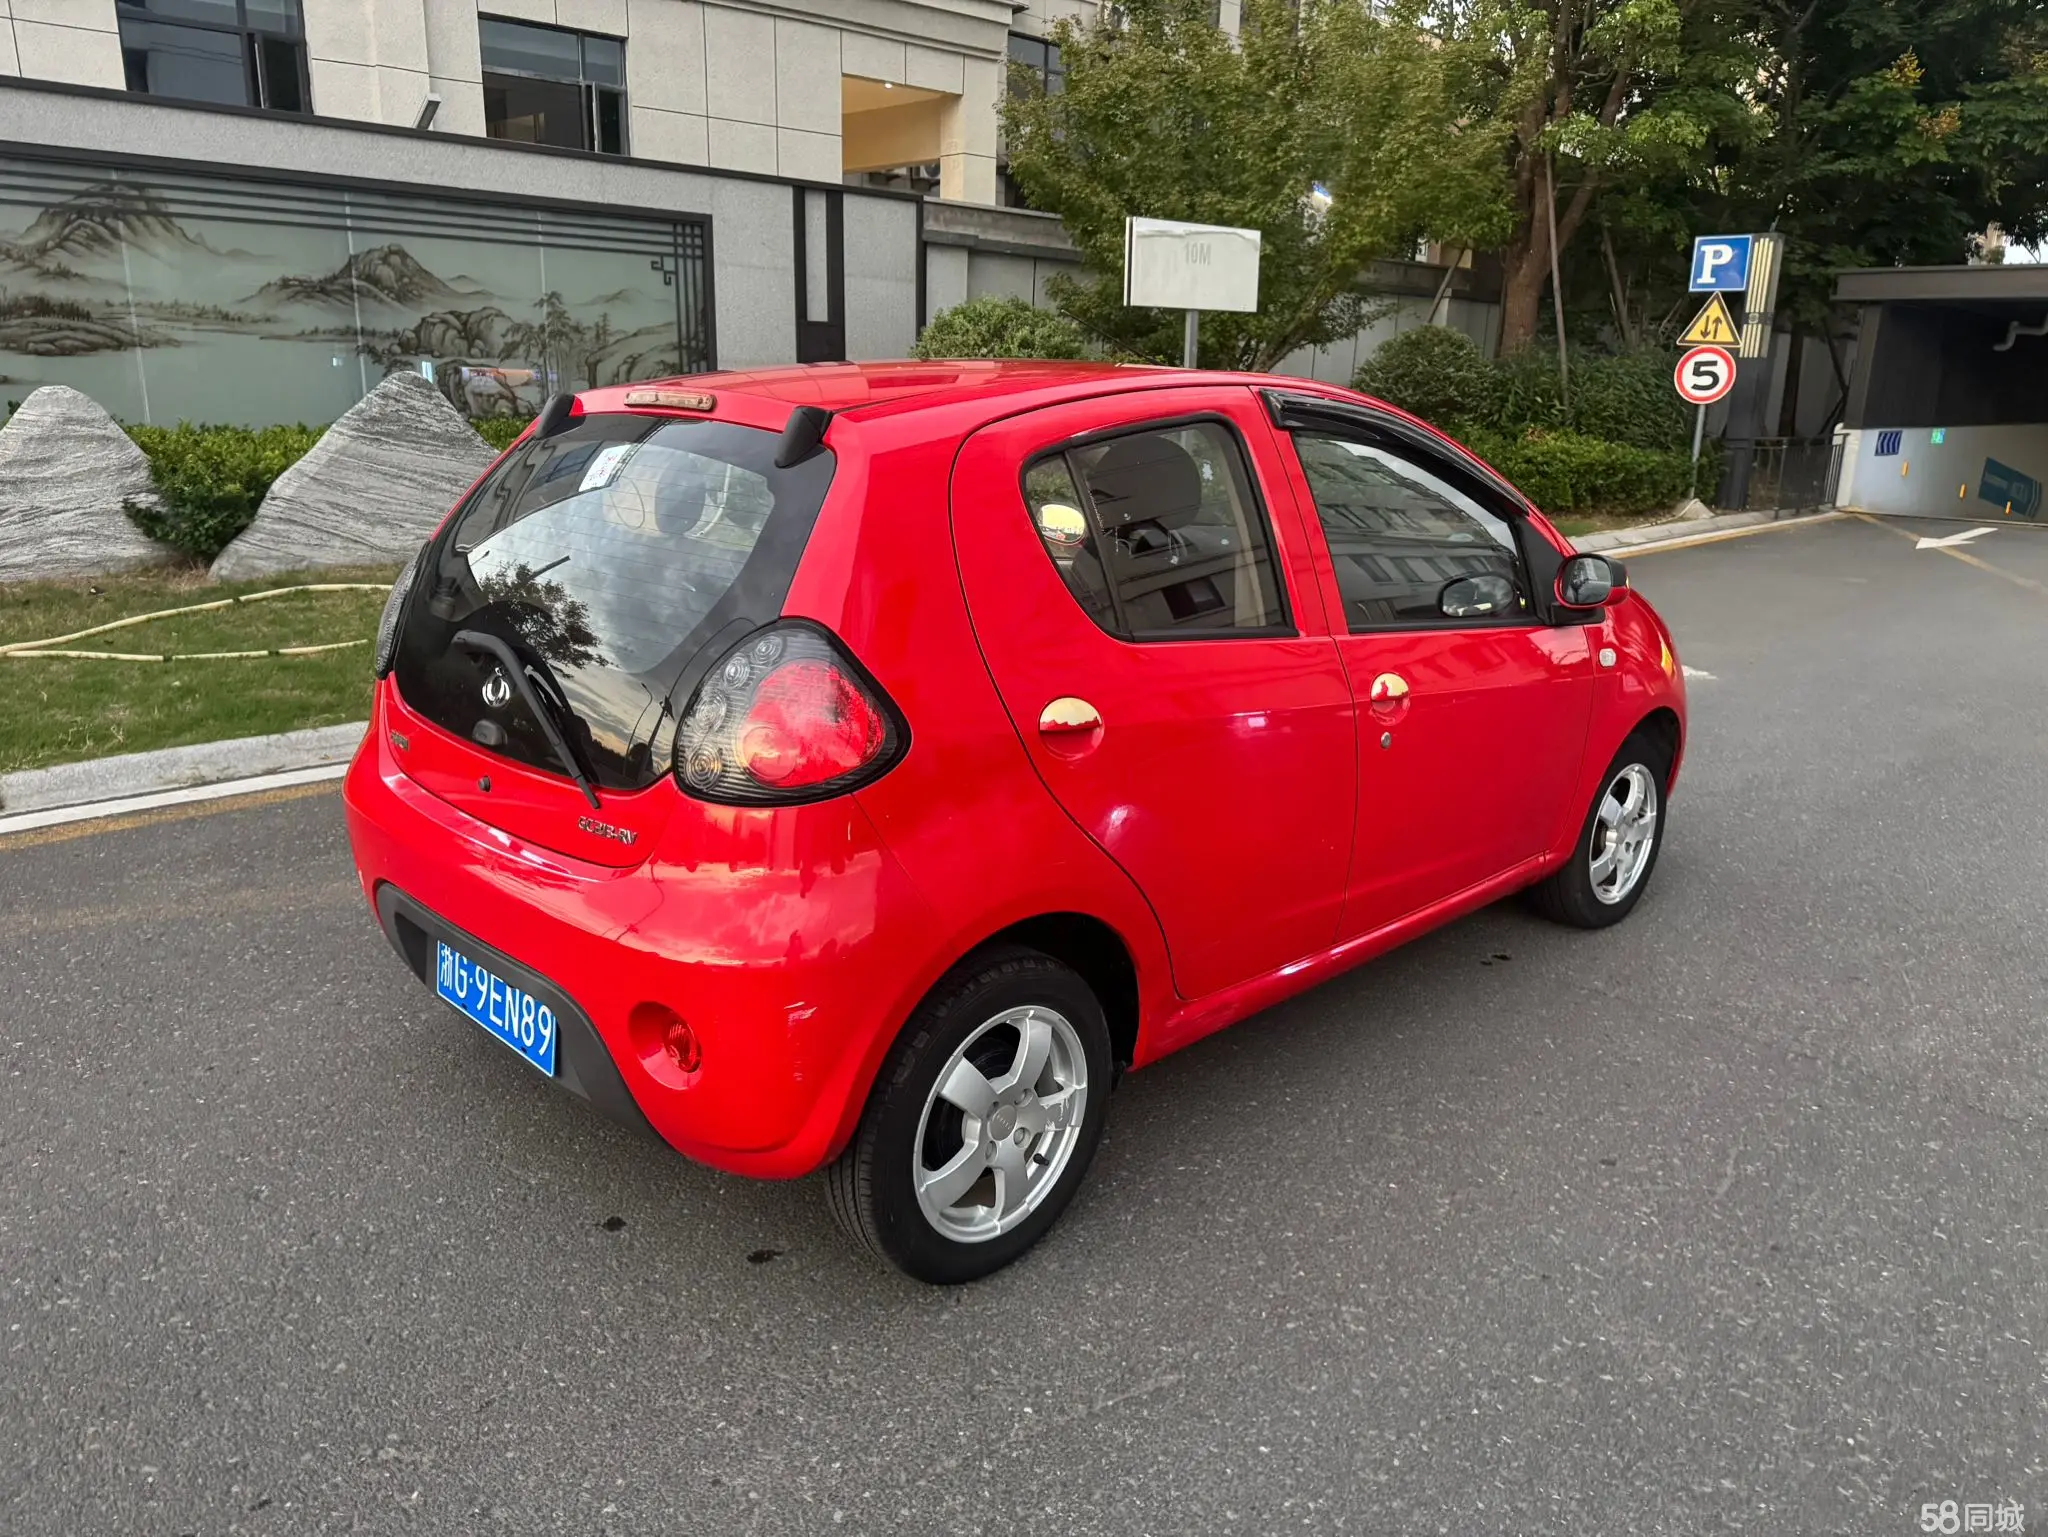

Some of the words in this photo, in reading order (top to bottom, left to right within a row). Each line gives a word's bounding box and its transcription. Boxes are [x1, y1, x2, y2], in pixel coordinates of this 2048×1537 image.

[1184, 243, 1212, 266] 10M
[1697, 243, 1733, 284] P
[1691, 360, 1720, 391] 5
